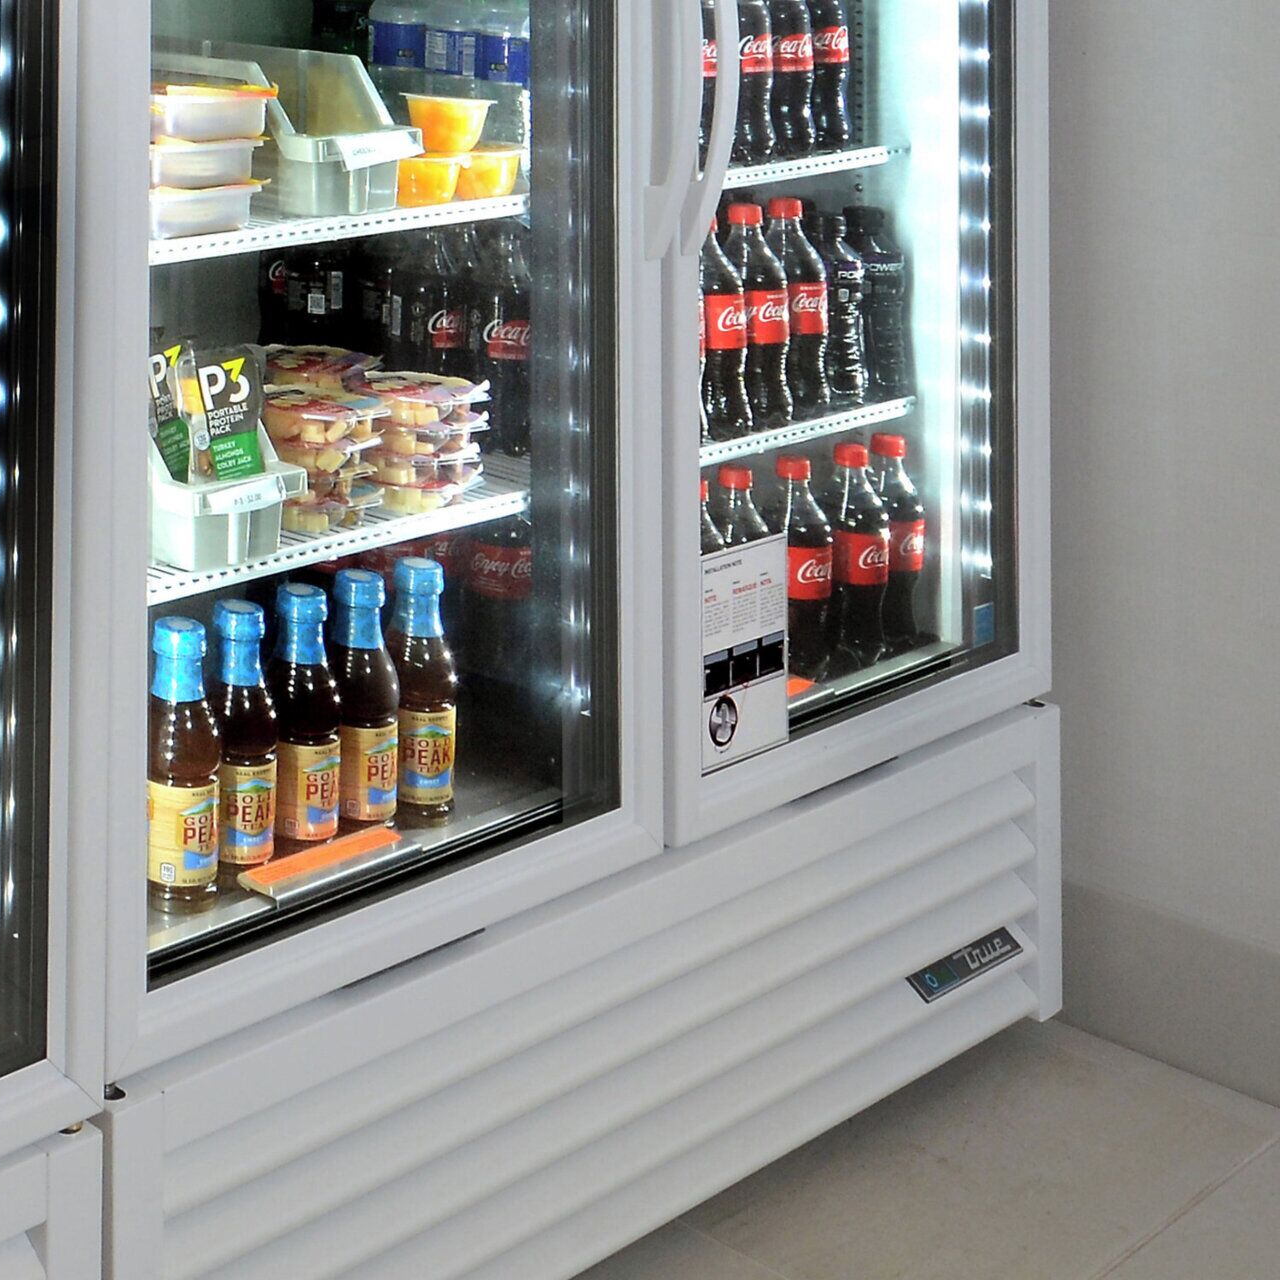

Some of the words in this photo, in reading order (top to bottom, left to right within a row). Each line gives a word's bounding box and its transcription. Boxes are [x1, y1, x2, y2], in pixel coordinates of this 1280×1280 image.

[197, 357, 251, 411] P3
[207, 402, 249, 420] PORTABLE
[209, 413, 244, 428] PROTEIN
[209, 424, 232, 437] PACK
[213, 441, 236, 451] TURKEY
[215, 450, 244, 461] ALMONDS
[402, 747, 451, 767] PEAK
[418, 765, 441, 773] TEA
[241, 821, 265, 830] TEA
